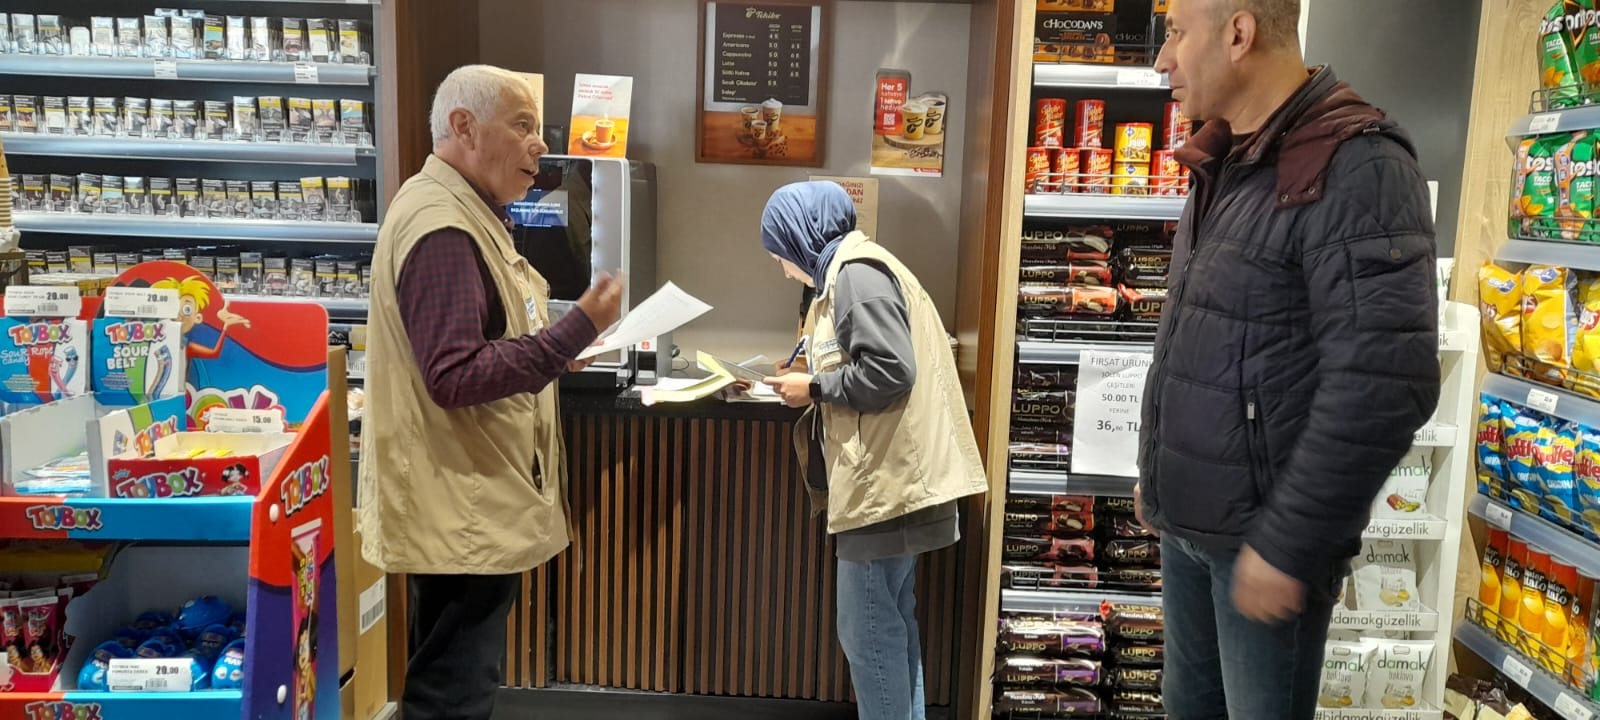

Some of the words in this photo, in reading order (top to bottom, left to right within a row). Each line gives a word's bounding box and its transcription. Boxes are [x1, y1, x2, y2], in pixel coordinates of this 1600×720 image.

[881, 82, 895, 91] Her
[896, 82, 903, 91] 5
[1024, 296, 1058, 305] LUPPO
[113, 345, 149, 358] SOUR
[107, 358, 137, 370] BELT
[1101, 393, 1127, 402] 50.00
[1129, 394, 1139, 403] TL
[1012, 403, 1061, 414] LUPPO
[1126, 421, 1141, 432] TL
[1387, 455, 1431, 477] amak
[1006, 513, 1039, 522] LUPPO
[1365, 522, 1430, 538] akgüzellik
[1006, 544, 1039, 552] LUPPO
[1366, 543, 1411, 563] damak
[1114, 550, 1148, 559] LUPPO
[1120, 626, 1154, 635] LUPPO
[1121, 647, 1156, 657] LUPPO
[1324, 652, 1365, 673] amak
[1377, 649, 1427, 672] damak
[1123, 670, 1157, 681] LUPPO
